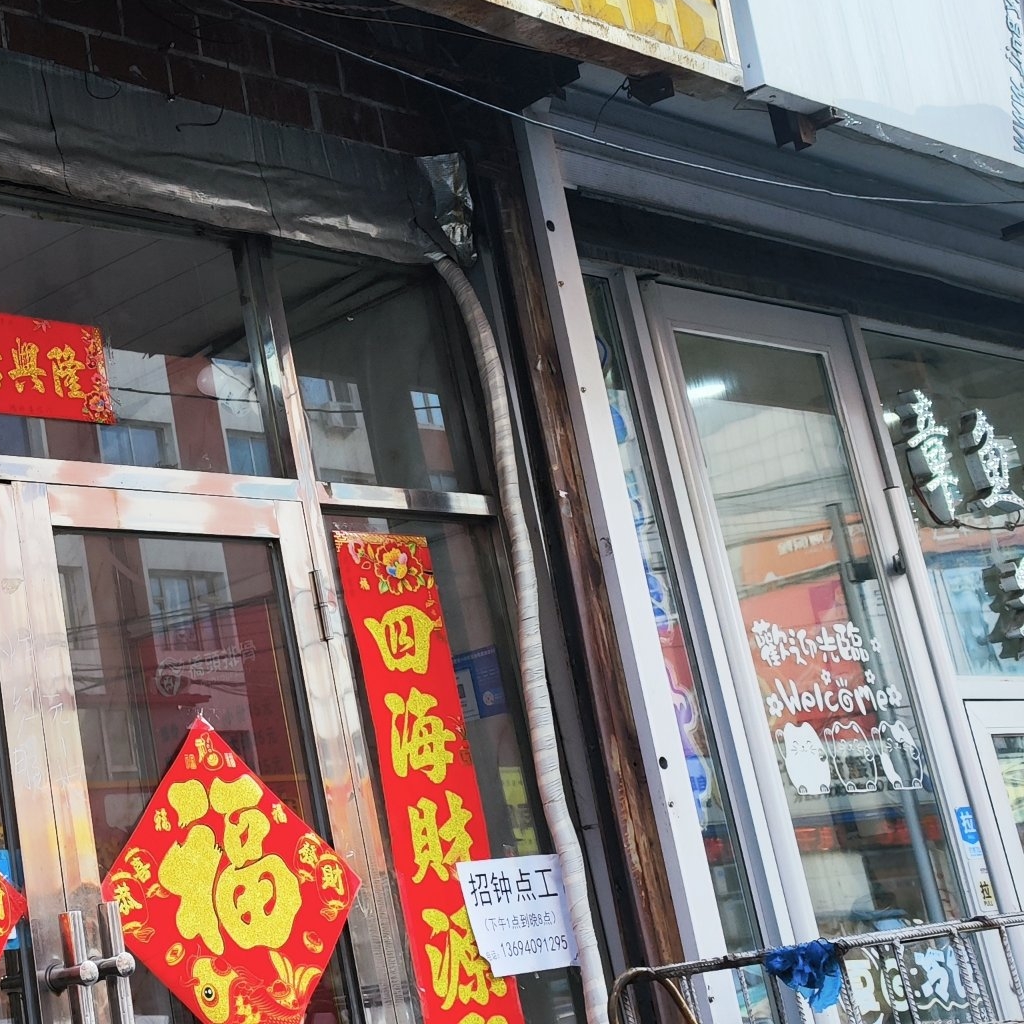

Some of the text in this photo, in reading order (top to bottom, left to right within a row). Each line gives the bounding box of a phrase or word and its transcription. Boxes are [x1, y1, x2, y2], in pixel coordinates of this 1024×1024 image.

[157, 773, 303, 957] 福
[364, 604, 510, 1024] 四海財源
[468, 868, 559, 908] 招钟点工
[499, 933, 569, 959] 13694091295
